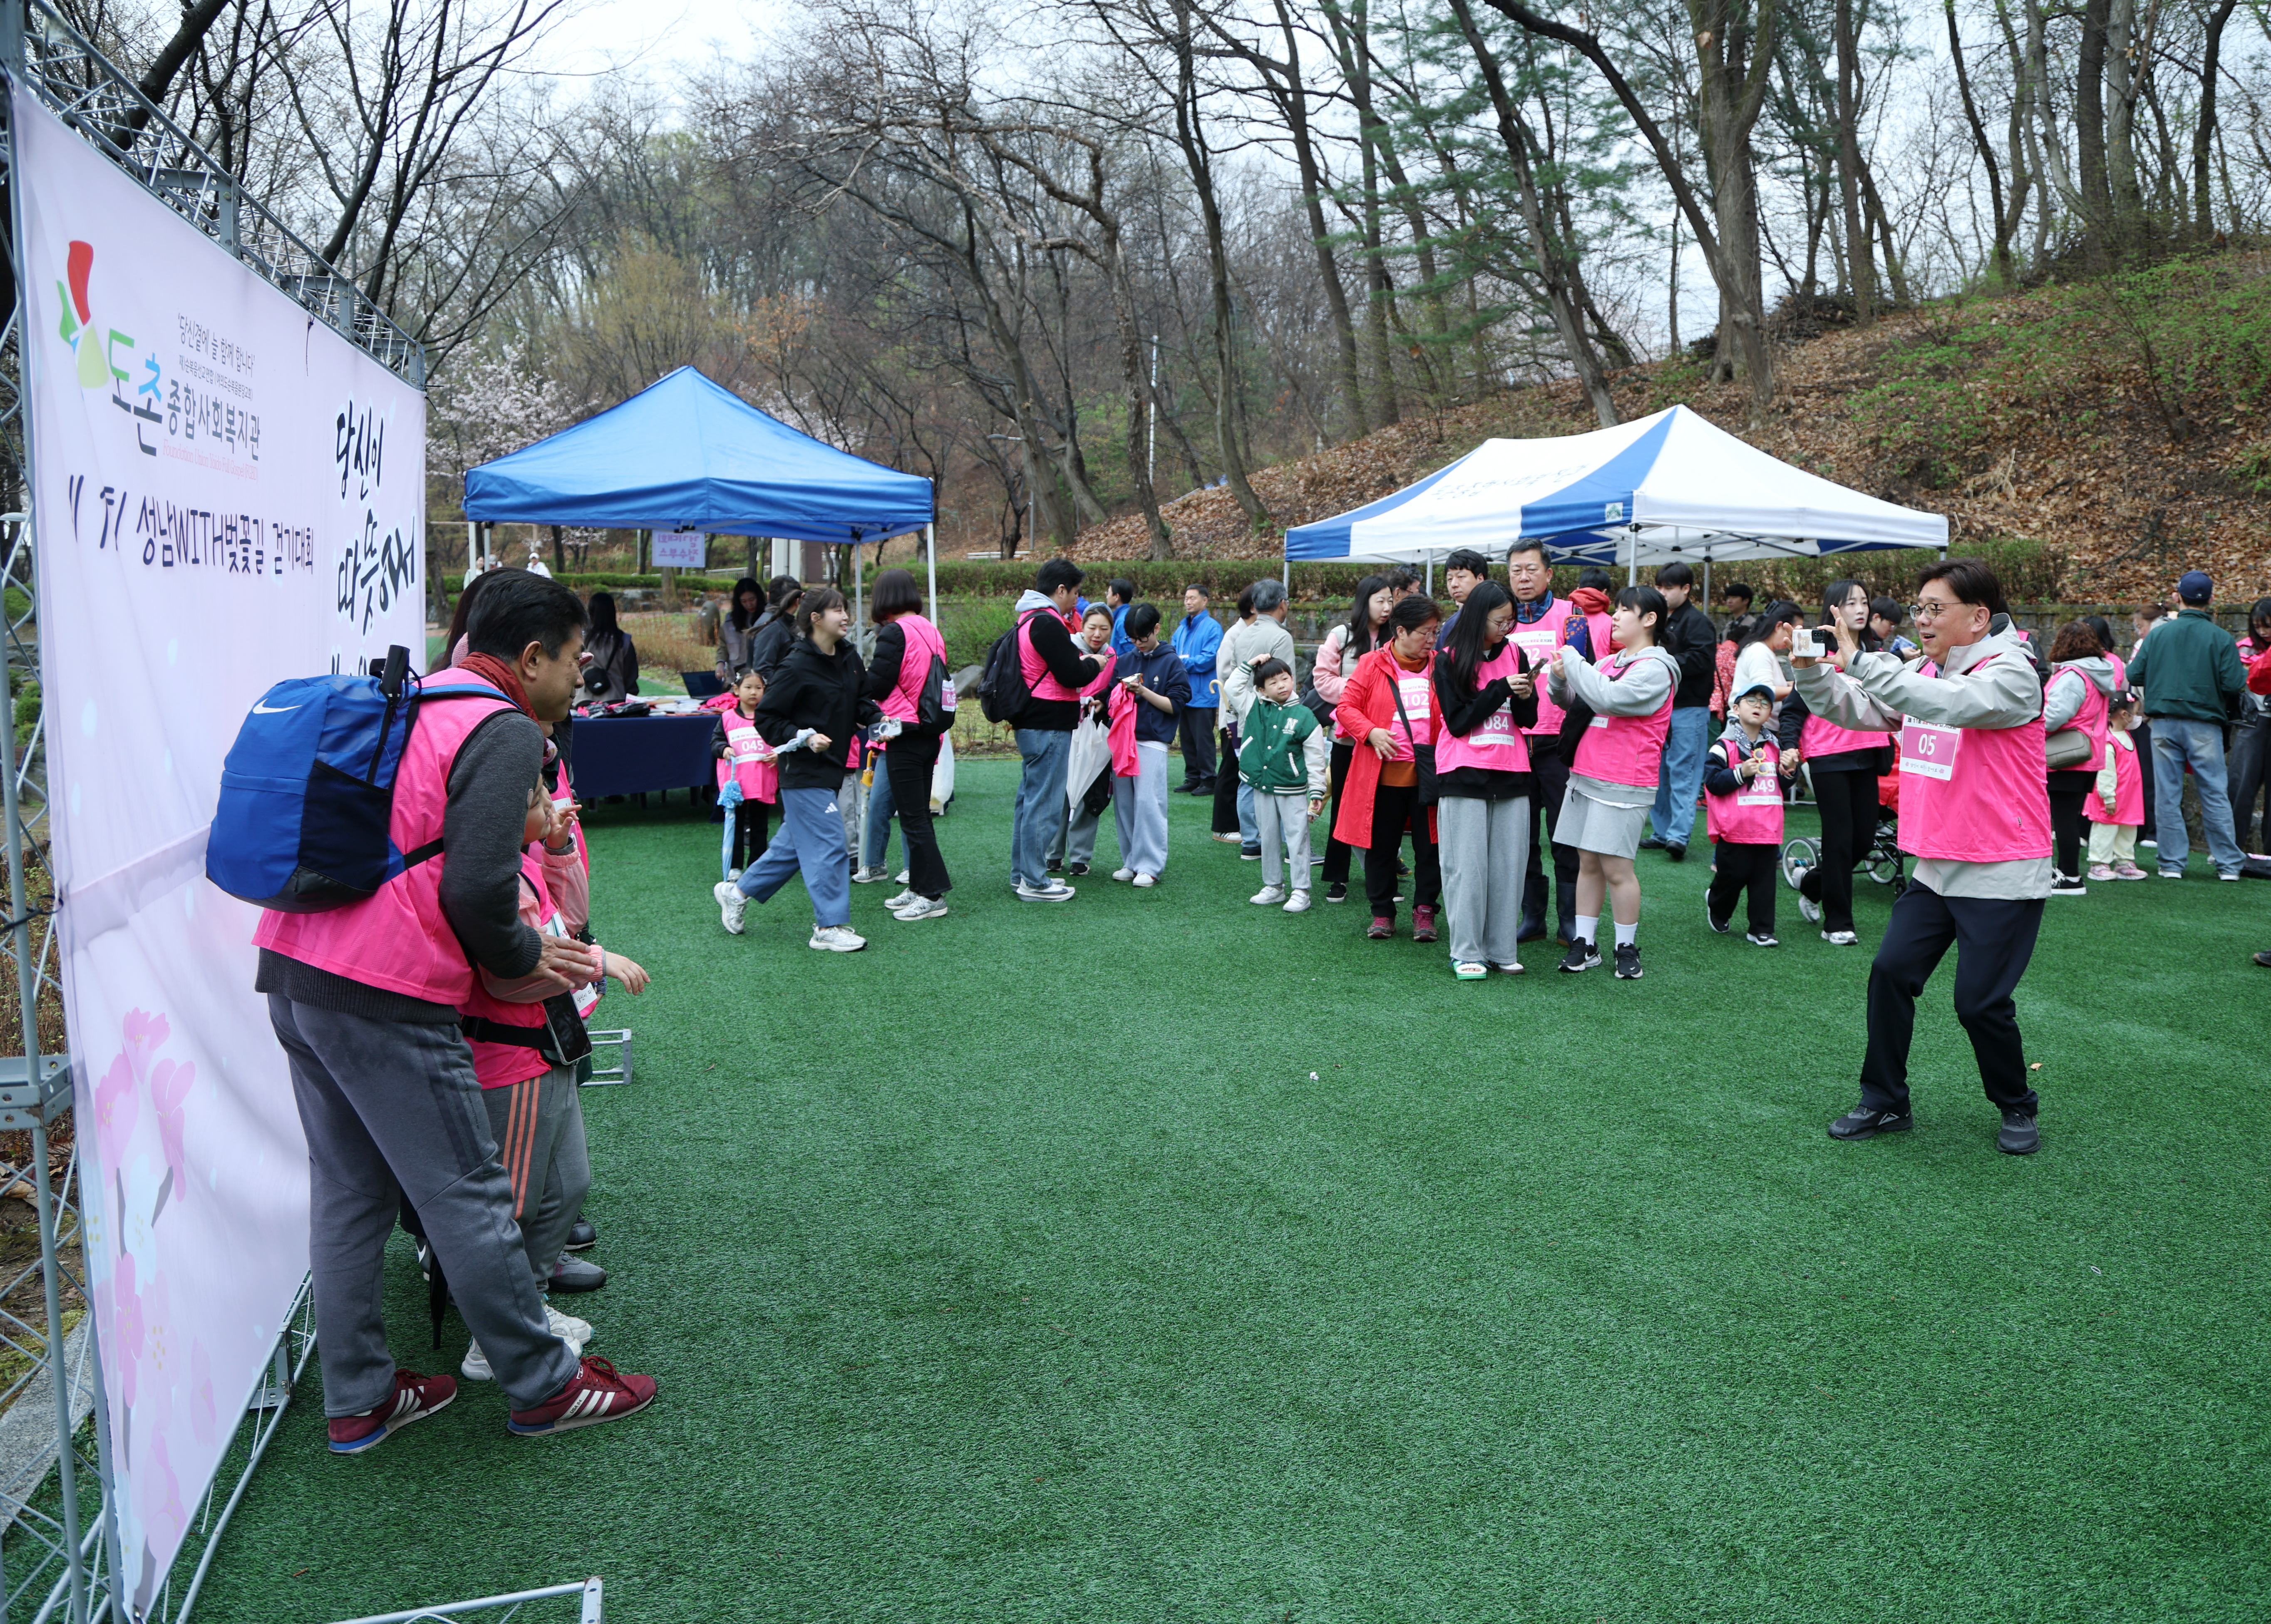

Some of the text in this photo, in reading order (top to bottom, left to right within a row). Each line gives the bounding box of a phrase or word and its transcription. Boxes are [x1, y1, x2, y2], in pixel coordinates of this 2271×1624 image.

[211, 332, 218, 360] 늘
[221, 338, 234, 368] 함께
[167, 378, 260, 461] 종합사회복지관
[336, 399, 384, 501] 당신이
[163, 439, 194, 463] Foundation
[195, 448, 208, 467] Union
[231, 460, 244, 480] Gospel
[273, 521, 313, 575] 걷기대회
[1402, 693, 1430, 707] 102
[1284, 717, 1298, 730] N
[1483, 715, 1509, 731] 084
[741, 740, 764, 752] 045
[1918, 733, 1937, 756] 05
[1751, 779, 1776, 793] 049
[576, 993, 588, 1003] 당신이
[569, 1405, 578, 1413] USA
